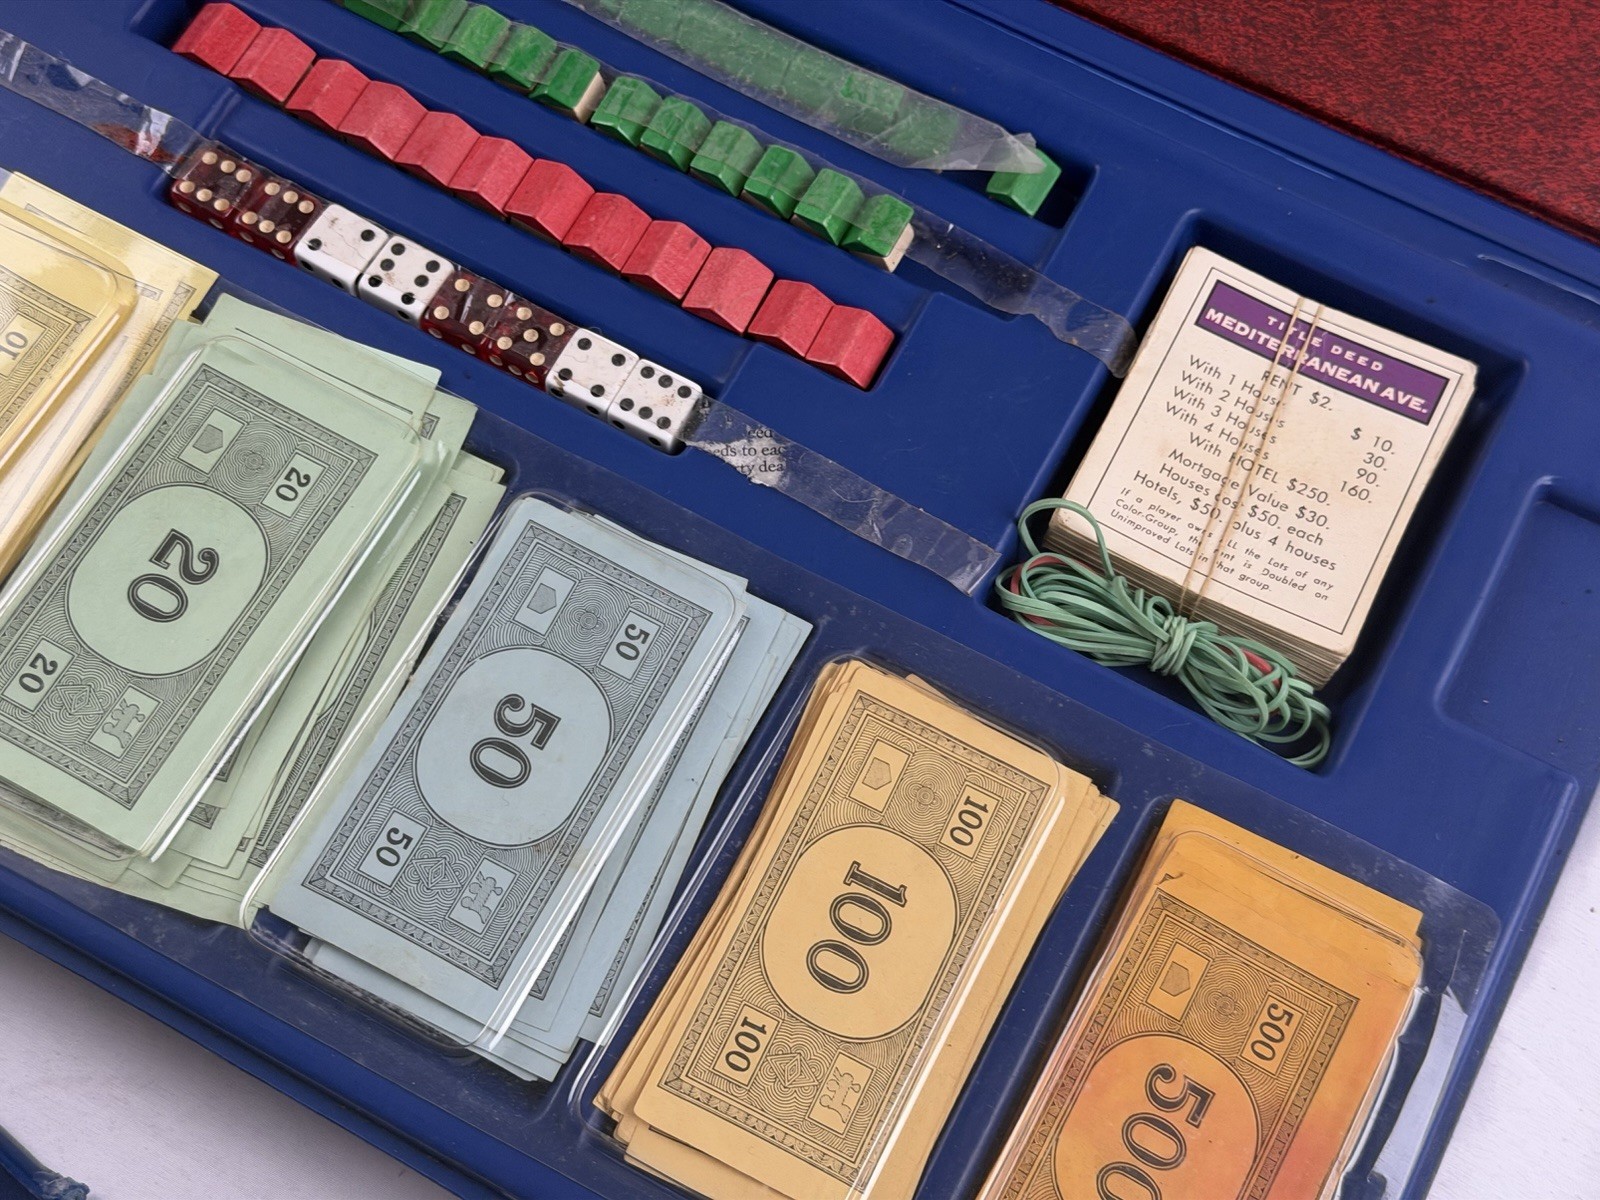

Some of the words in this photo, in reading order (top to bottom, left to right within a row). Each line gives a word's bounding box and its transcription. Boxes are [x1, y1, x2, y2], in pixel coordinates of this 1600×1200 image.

[1205, 308, 1380, 395] MEDITERRANEAN
[1381, 387, 1428, 414] AVE.
[1267, 315, 1323, 347] TITLE
[1331, 345, 1384, 372] DEED
[1182, 370, 1213, 395] With
[1219, 390, 1231, 402] 2
[1363, 452, 1387, 471] 30.
[1190, 354, 1222, 379] With
[1229, 374, 1236, 386] 1
[1350, 427, 1362, 440] $
[1373, 436, 1395, 455] 10.
[1261, 370, 1303, 396] RENT
[1309, 391, 1332, 411] $2.
[742, 446, 757, 457] to
[1166, 401, 1198, 426] With
[1204, 422, 1215, 433] 4
[1340, 480, 1372, 504] 160.
[1174, 386, 1206, 411] With
[1211, 405, 1222, 417] 3
[1356, 468, 1381, 487] 90.
[1190, 432, 1222, 457] With
[1229, 452, 1279, 484] HOTEL
[1286, 478, 1330, 506] $250.
[275, 466, 312, 502] 20
[1133, 470, 1182, 505] Hotels,
[1190, 497, 1223, 523] $50.
[1268, 535, 1279, 546] 4
[1285, 541, 1337, 571] houses
[1159, 463, 1210, 496] Houses
[1214, 493, 1244, 509] cos
[1248, 504, 1281, 530] $50.
[1287, 525, 1324, 545] each
[1168, 449, 1240, 490] Mortgage
[1249, 484, 1289, 512] Value
[1295, 505, 1330, 530] $30.
[127, 528, 220, 623] 20
[1110, 509, 1172, 544] Unimproved
[1174, 541, 1195, 556] Lots
[1197, 553, 1209, 563] in
[1215, 560, 1235, 575] hat
[1238, 573, 1272, 592] group.
[1115, 498, 1179, 537] Color-Group,
[1243, 560, 1252, 569] is
[1262, 568, 1307, 591] Doubled
[1314, 592, 1329, 601] on
[1120, 487, 1131, 497] If
[1148, 503, 1182, 523] player
[1245, 548, 1261, 560] the
[1268, 557, 1290, 571] Lots
[1295, 570, 1308, 578] of
[1313, 578, 1335, 591] any
[18, 652, 58, 694] 20
[615, 623, 650, 662] 50
[469, 693, 562, 789] 50
[376, 826, 414, 867] 50
[949, 795, 989, 847] 100
[805, 860, 908, 994] 100
[725, 1015, 767, 1073] 100
[1250, 1002, 1294, 1061] 500
[1096, 1063, 1217, 1200] 500
